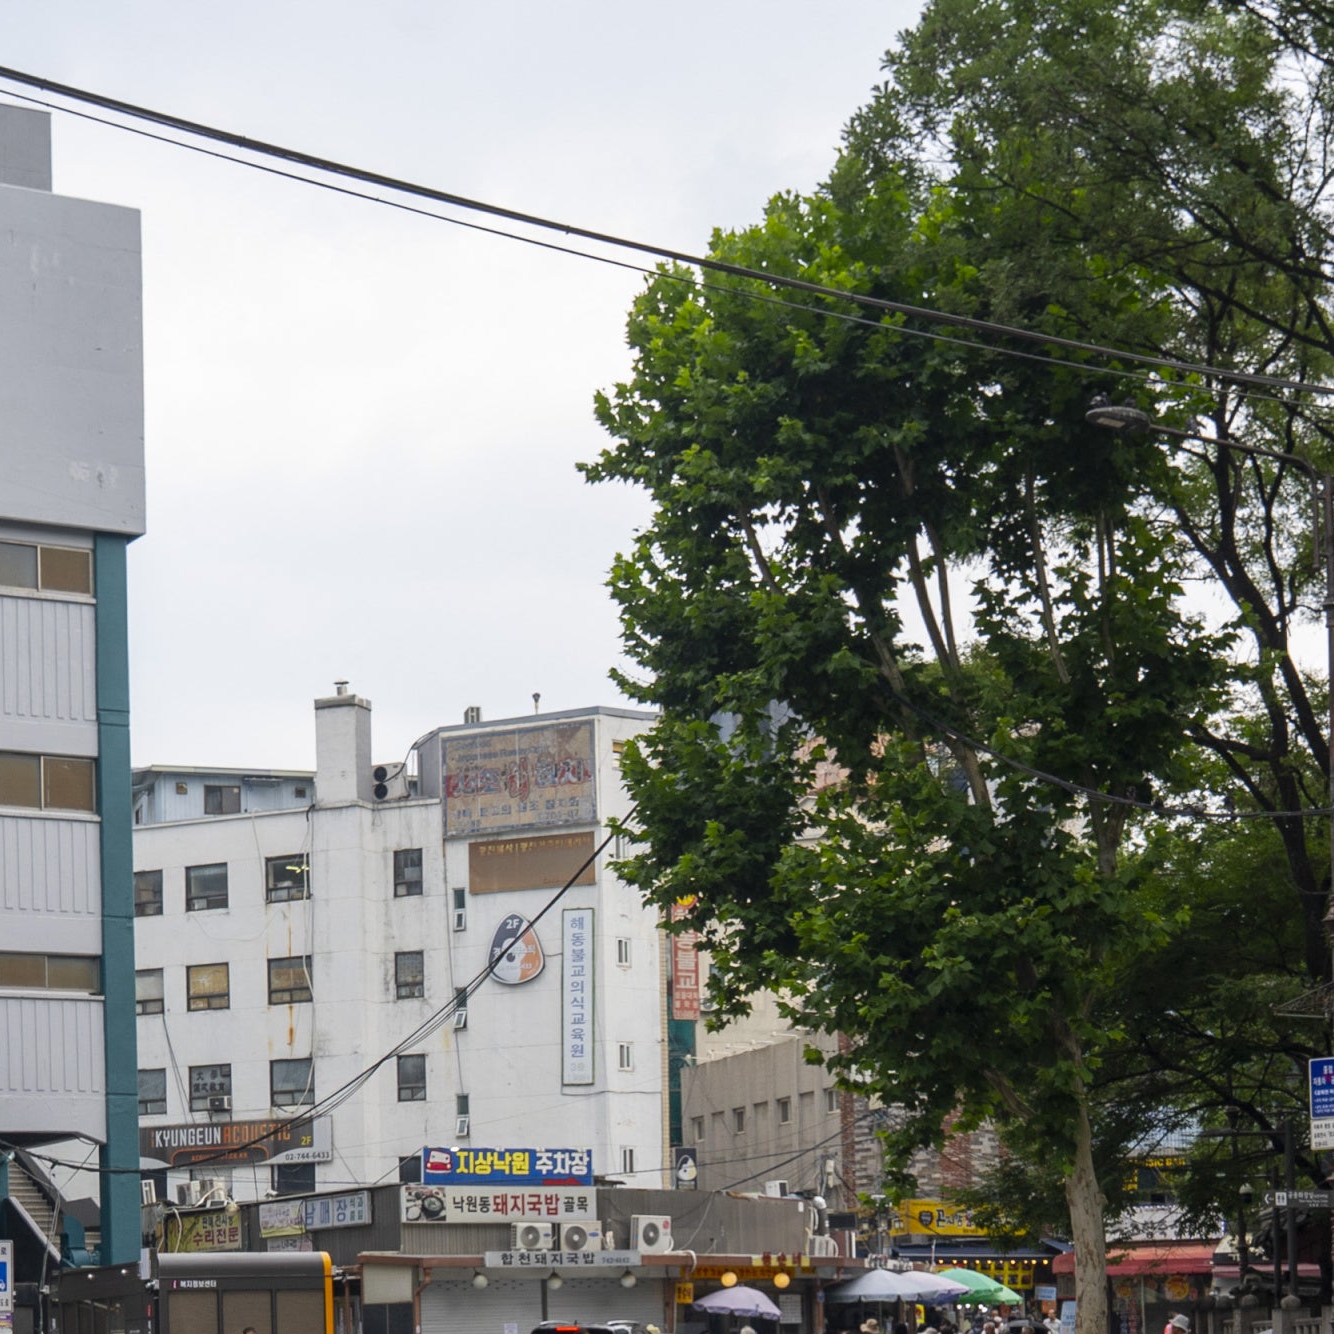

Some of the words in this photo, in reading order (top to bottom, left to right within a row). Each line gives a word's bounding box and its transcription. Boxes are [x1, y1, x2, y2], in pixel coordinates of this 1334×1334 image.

[505, 918, 520, 930] 2F
[570, 915, 586, 1059] 해동불교의식교육원
[155, 1126, 222, 1148] KYUNGEUN
[222, 1123, 292, 1143] ACOUSTIC
[300, 1135, 312, 1146] 2F
[285, 1151, 330, 1161] 02-744-6433
[455, 1150, 530, 1175] 지상낙원
[534, 1150, 590, 1176] 주차장
[452, 1195, 491, 1213] 낙원동
[492, 1192, 560, 1217] 돼지국밥
[563, 1195, 589, 1213] 골목
[192, 1225, 240, 1247] 수리전문
[500, 1250, 596, 1266] 합천돼지국밥
[179, 1279, 217, 1288] 복지정보센터
